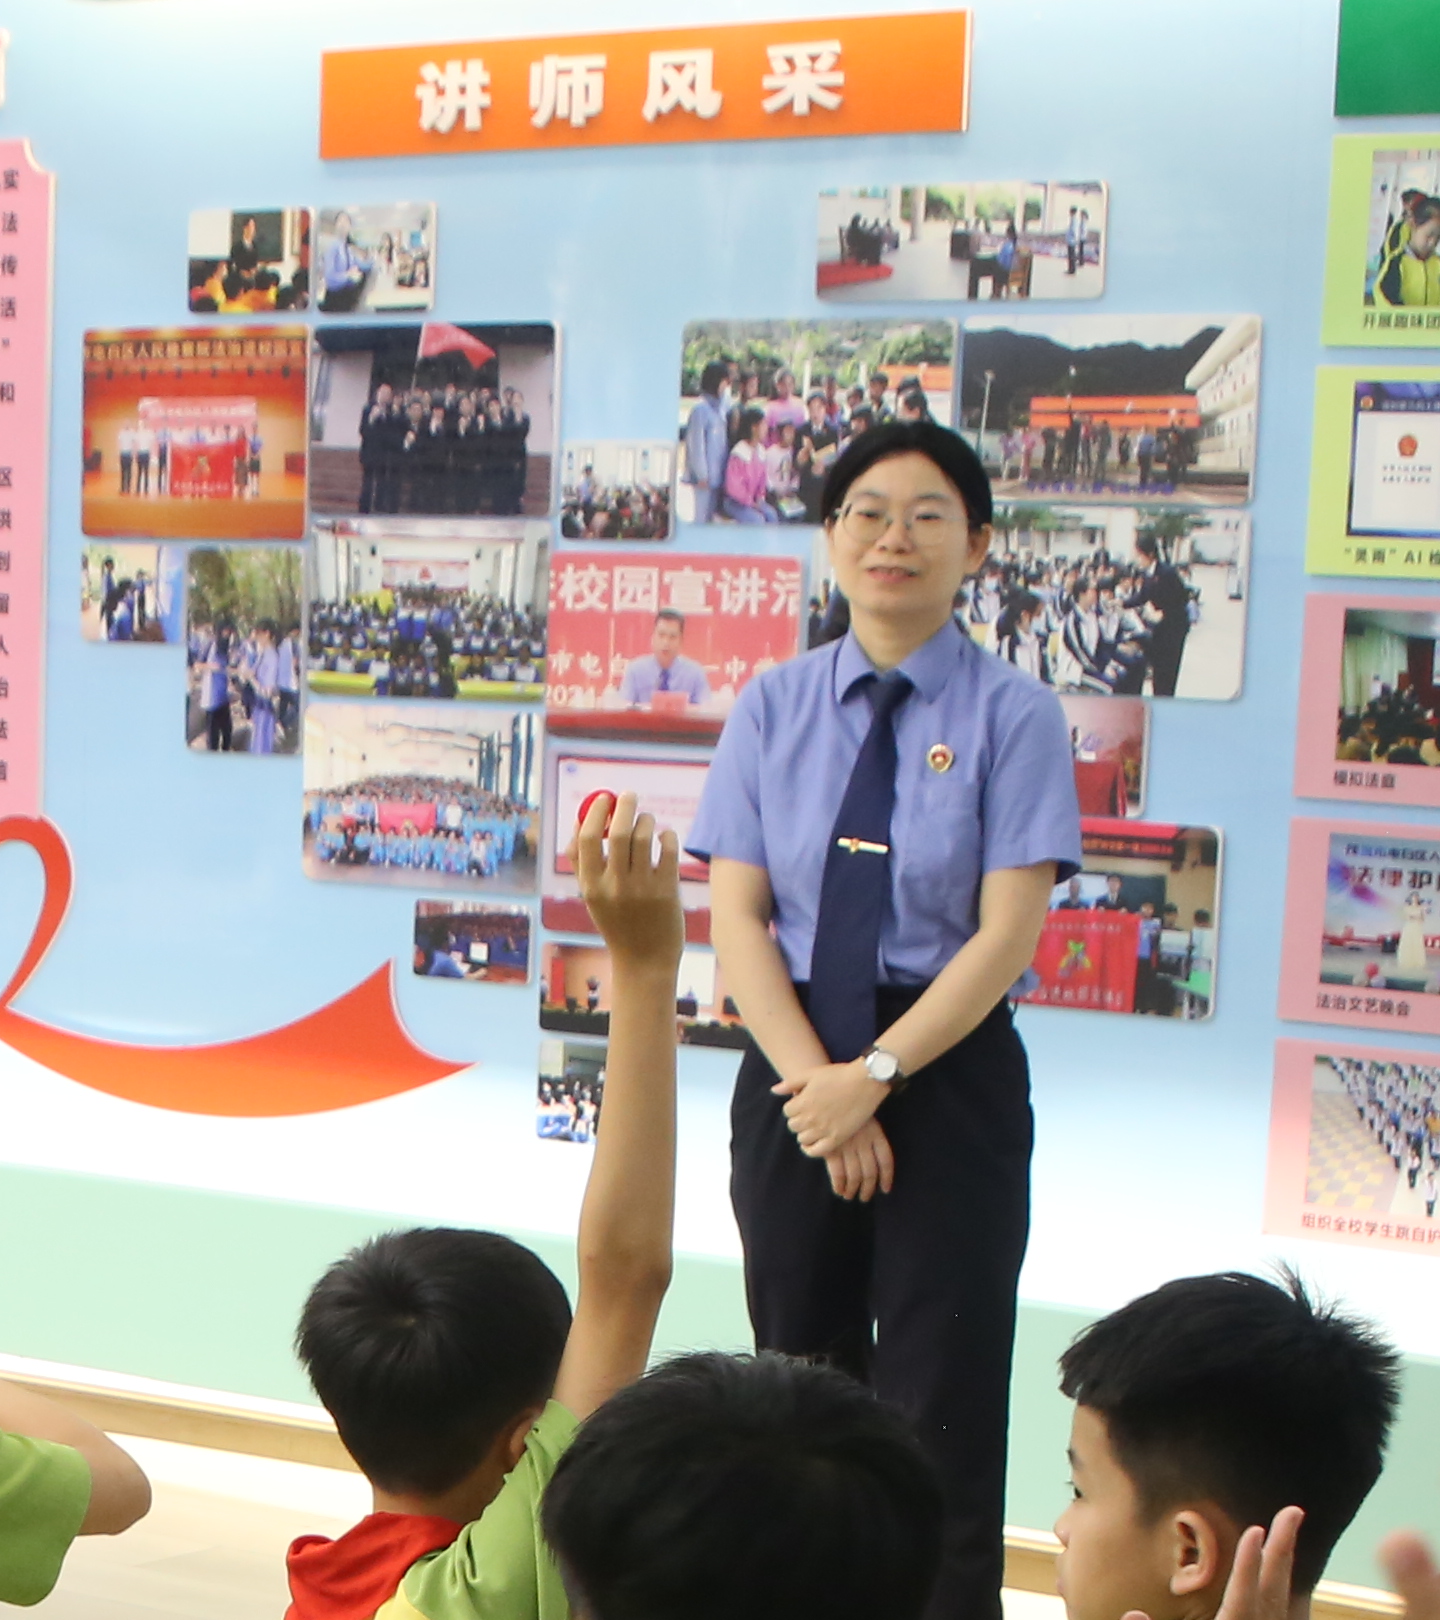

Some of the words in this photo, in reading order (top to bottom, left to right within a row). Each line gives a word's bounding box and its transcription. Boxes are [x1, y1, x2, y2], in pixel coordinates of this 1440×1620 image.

[415, 39, 845, 133] 讲师风采
[550, 562, 801, 617] 校园宣讲活
[1332, 769, 1396, 789] 模拟法庭
[1316, 993, 1410, 1018] 法治文艺晚会
